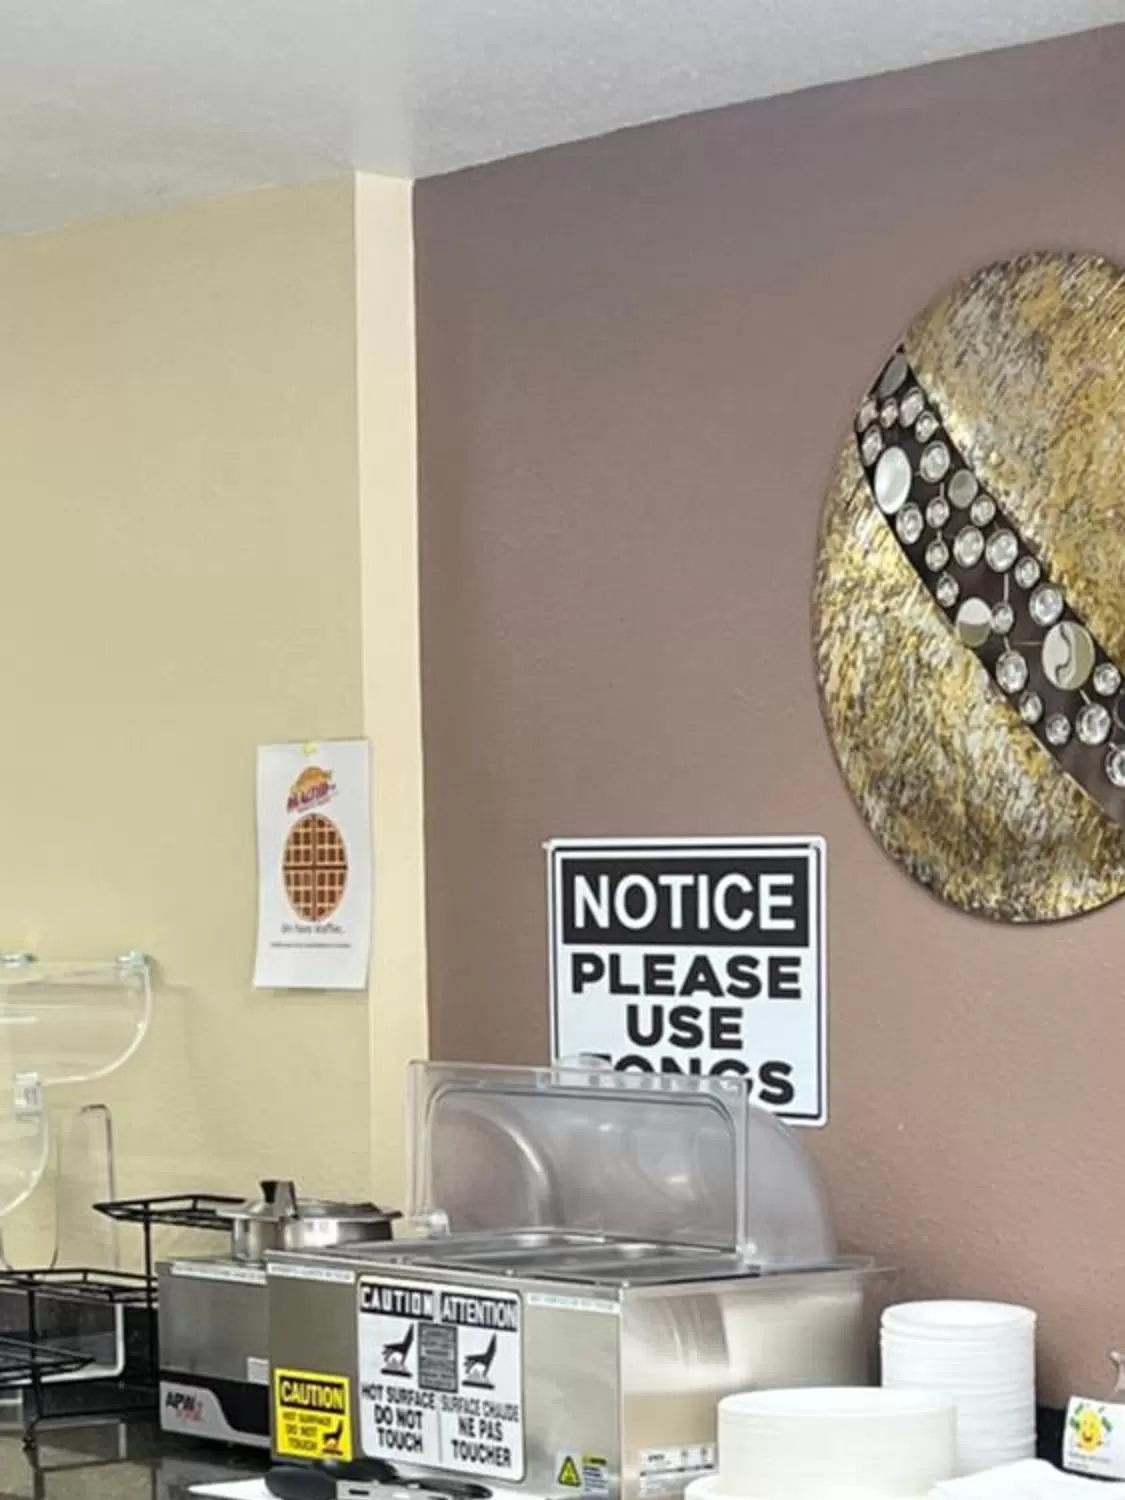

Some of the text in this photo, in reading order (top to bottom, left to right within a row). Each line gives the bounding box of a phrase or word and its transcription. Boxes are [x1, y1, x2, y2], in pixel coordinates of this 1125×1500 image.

[573, 873, 796, 931] NOTICE
[571, 952, 802, 1000] PLEASE
[626, 1004, 744, 1051] USE
[360, 1286, 433, 1317] CAUTION
[443, 1295, 517, 1328] ATTENTION
[281, 1380, 344, 1409] CAUTION
[361, 1384, 436, 1411] HOT SURFACE
[441, 1394, 519, 1423] SURFACE CHAUDE
[374, 1404, 424, 1430] DO NOT
[458, 1415, 504, 1442] NE PAS
[376, 1426, 424, 1454] TOUCH
[451, 1438, 512, 1469] TOUCHER
